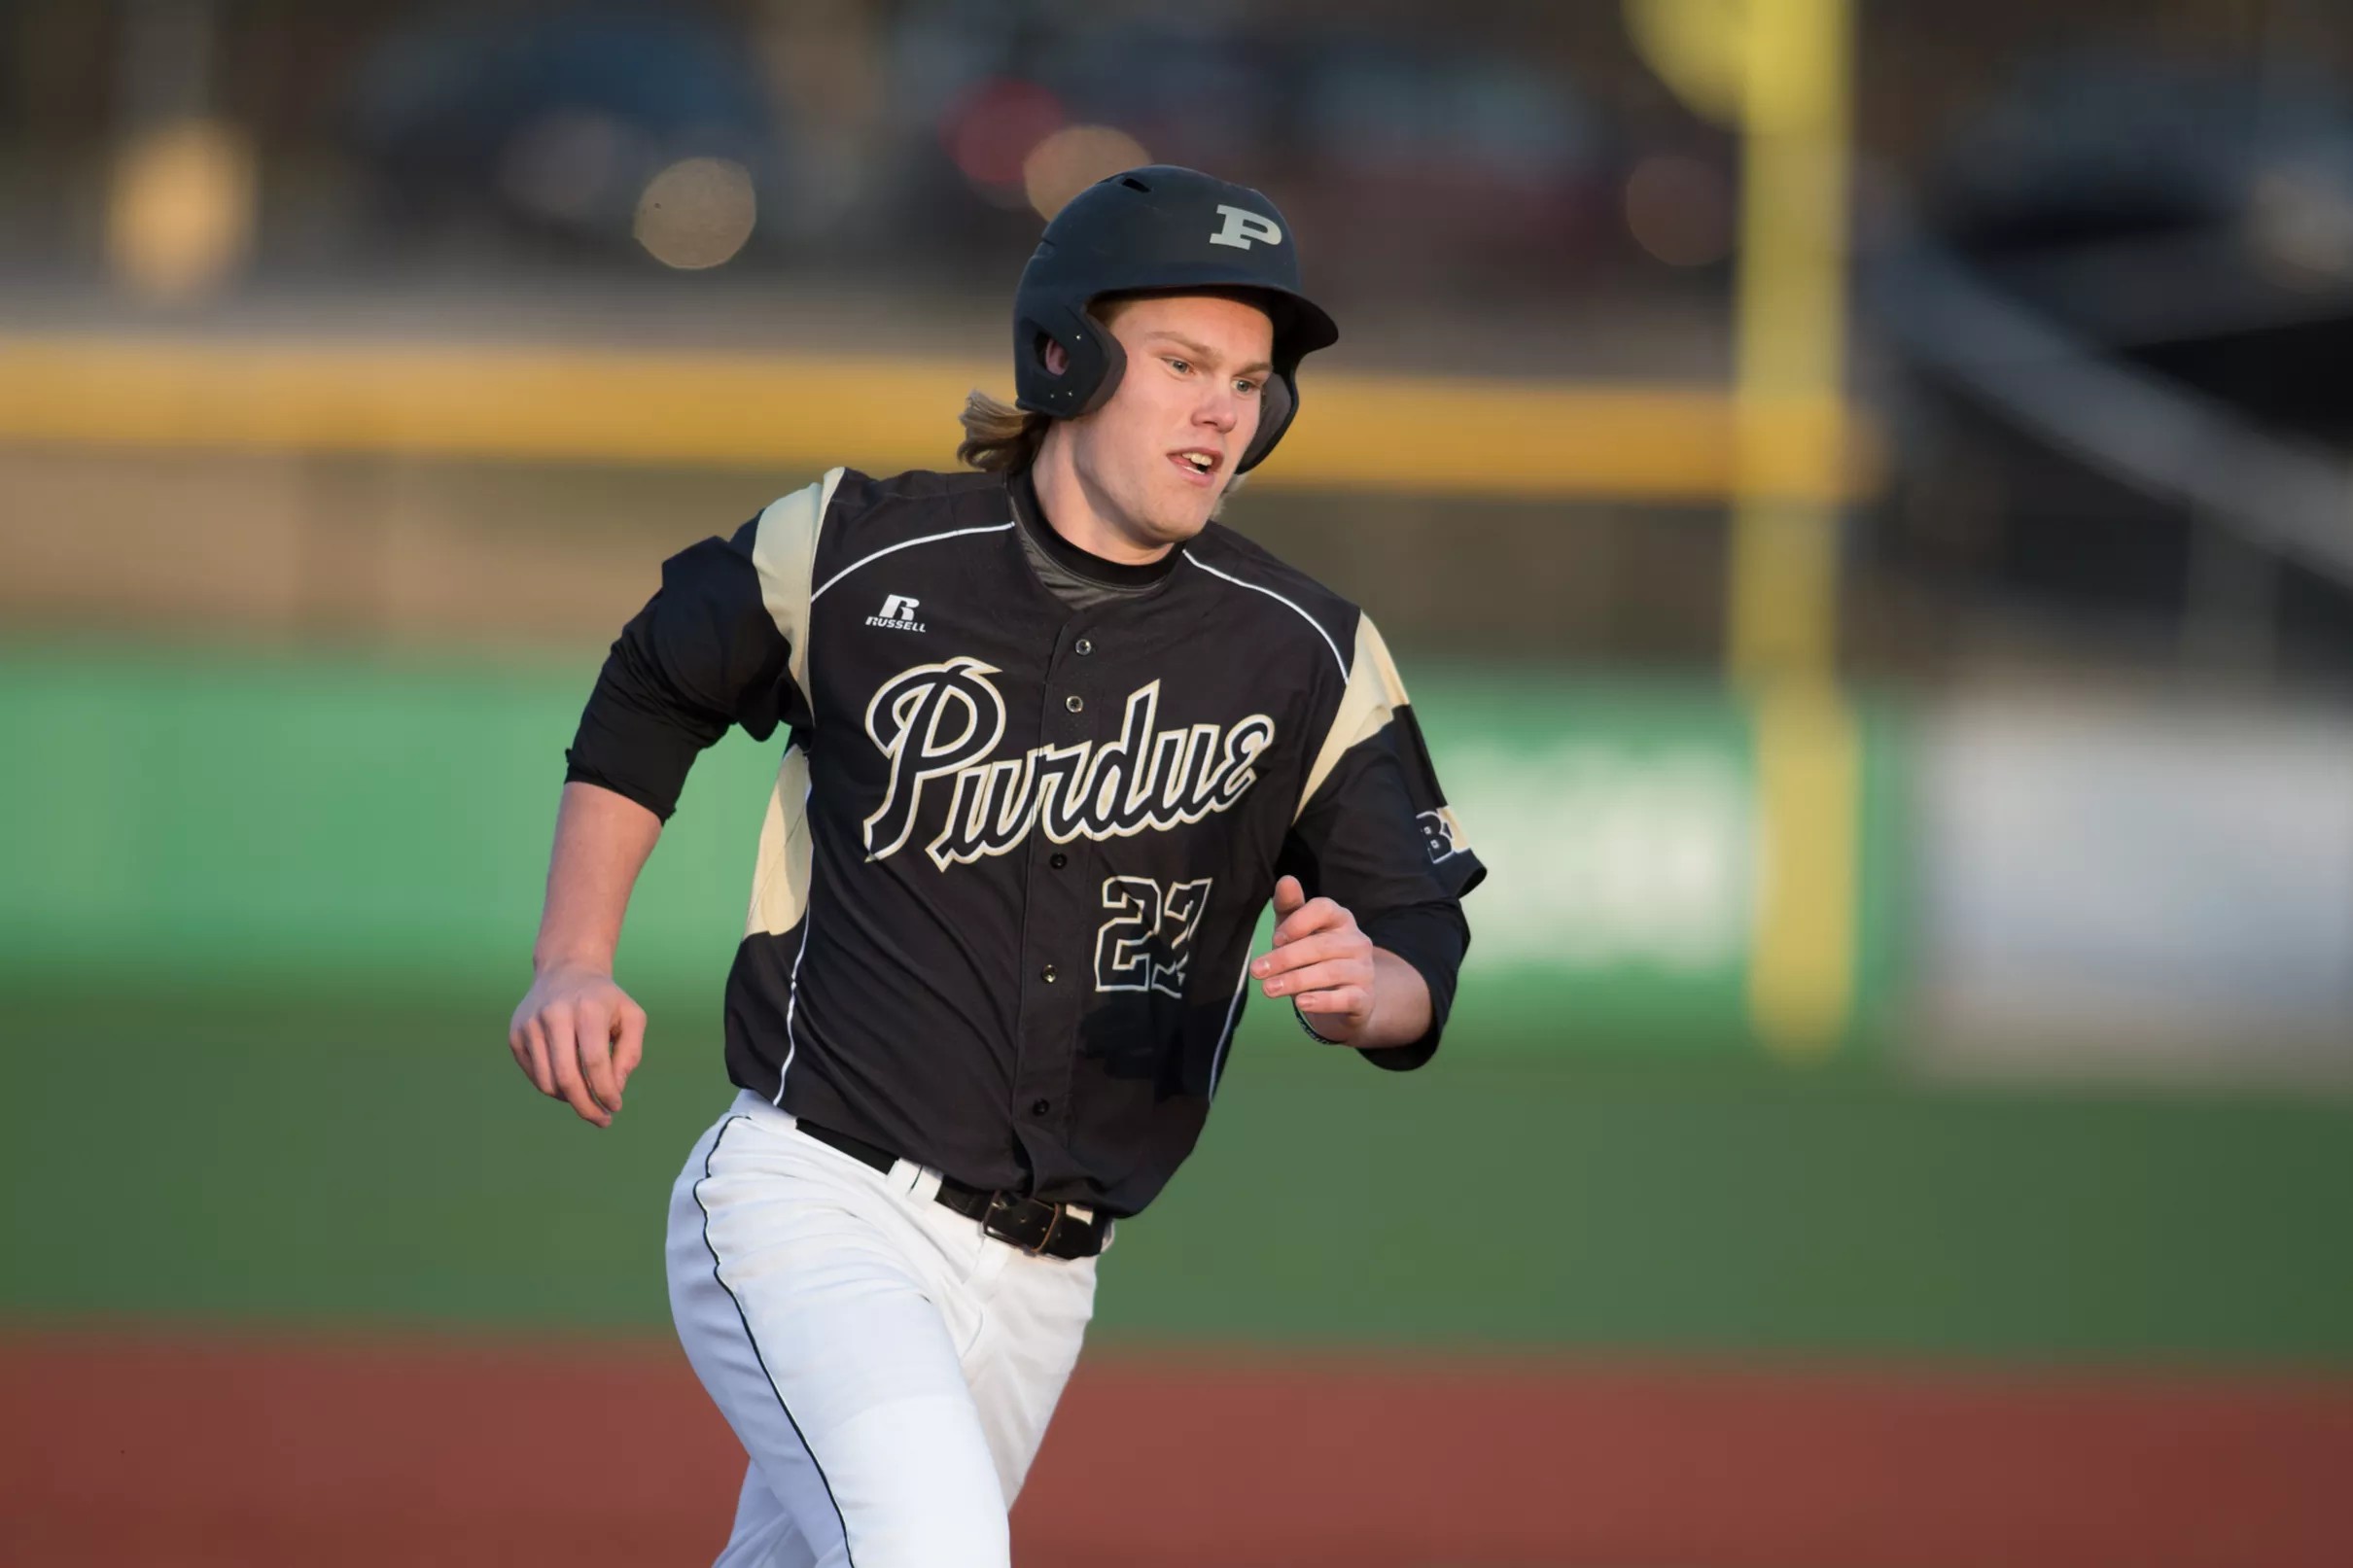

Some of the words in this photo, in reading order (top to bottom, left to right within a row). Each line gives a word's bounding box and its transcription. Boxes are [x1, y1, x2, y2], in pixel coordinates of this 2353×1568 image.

[1209, 204, 1282, 250] P
[864, 615, 927, 633] RUSSELL
[864, 656, 1275, 873] Purdue
